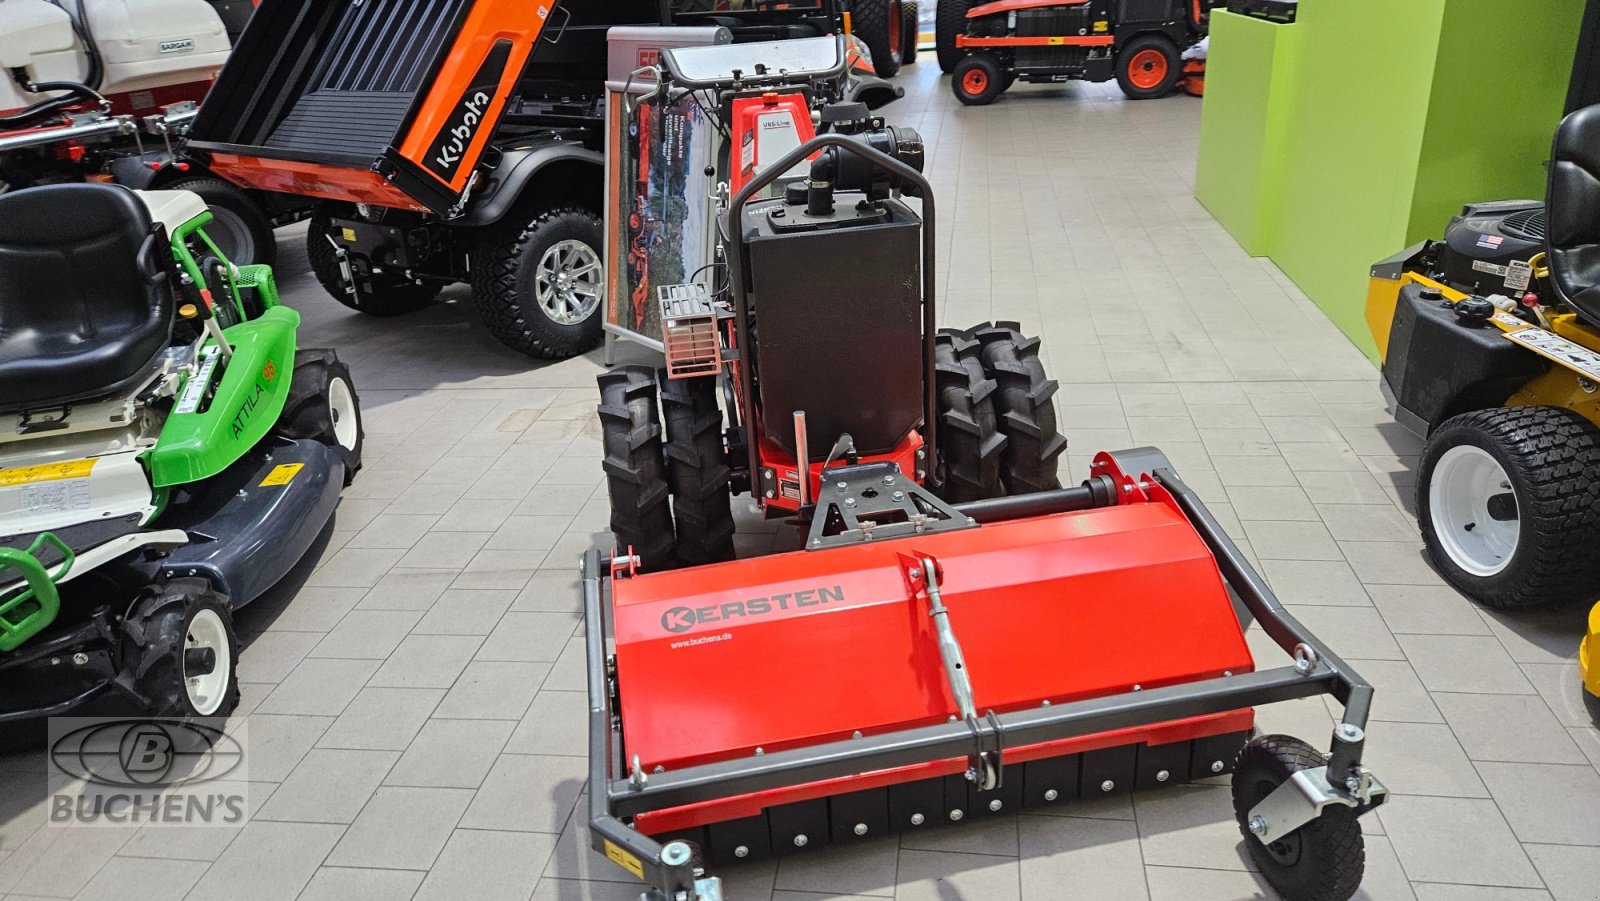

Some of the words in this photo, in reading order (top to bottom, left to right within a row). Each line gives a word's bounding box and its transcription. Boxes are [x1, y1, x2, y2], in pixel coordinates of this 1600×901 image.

[436, 91, 489, 168] Kubota
[232, 383, 264, 441] ATTILA
[262, 359, 276, 383] 98
[661, 585, 844, 633] KERSTEN
[671, 632, 732, 649] www.buchens.de
